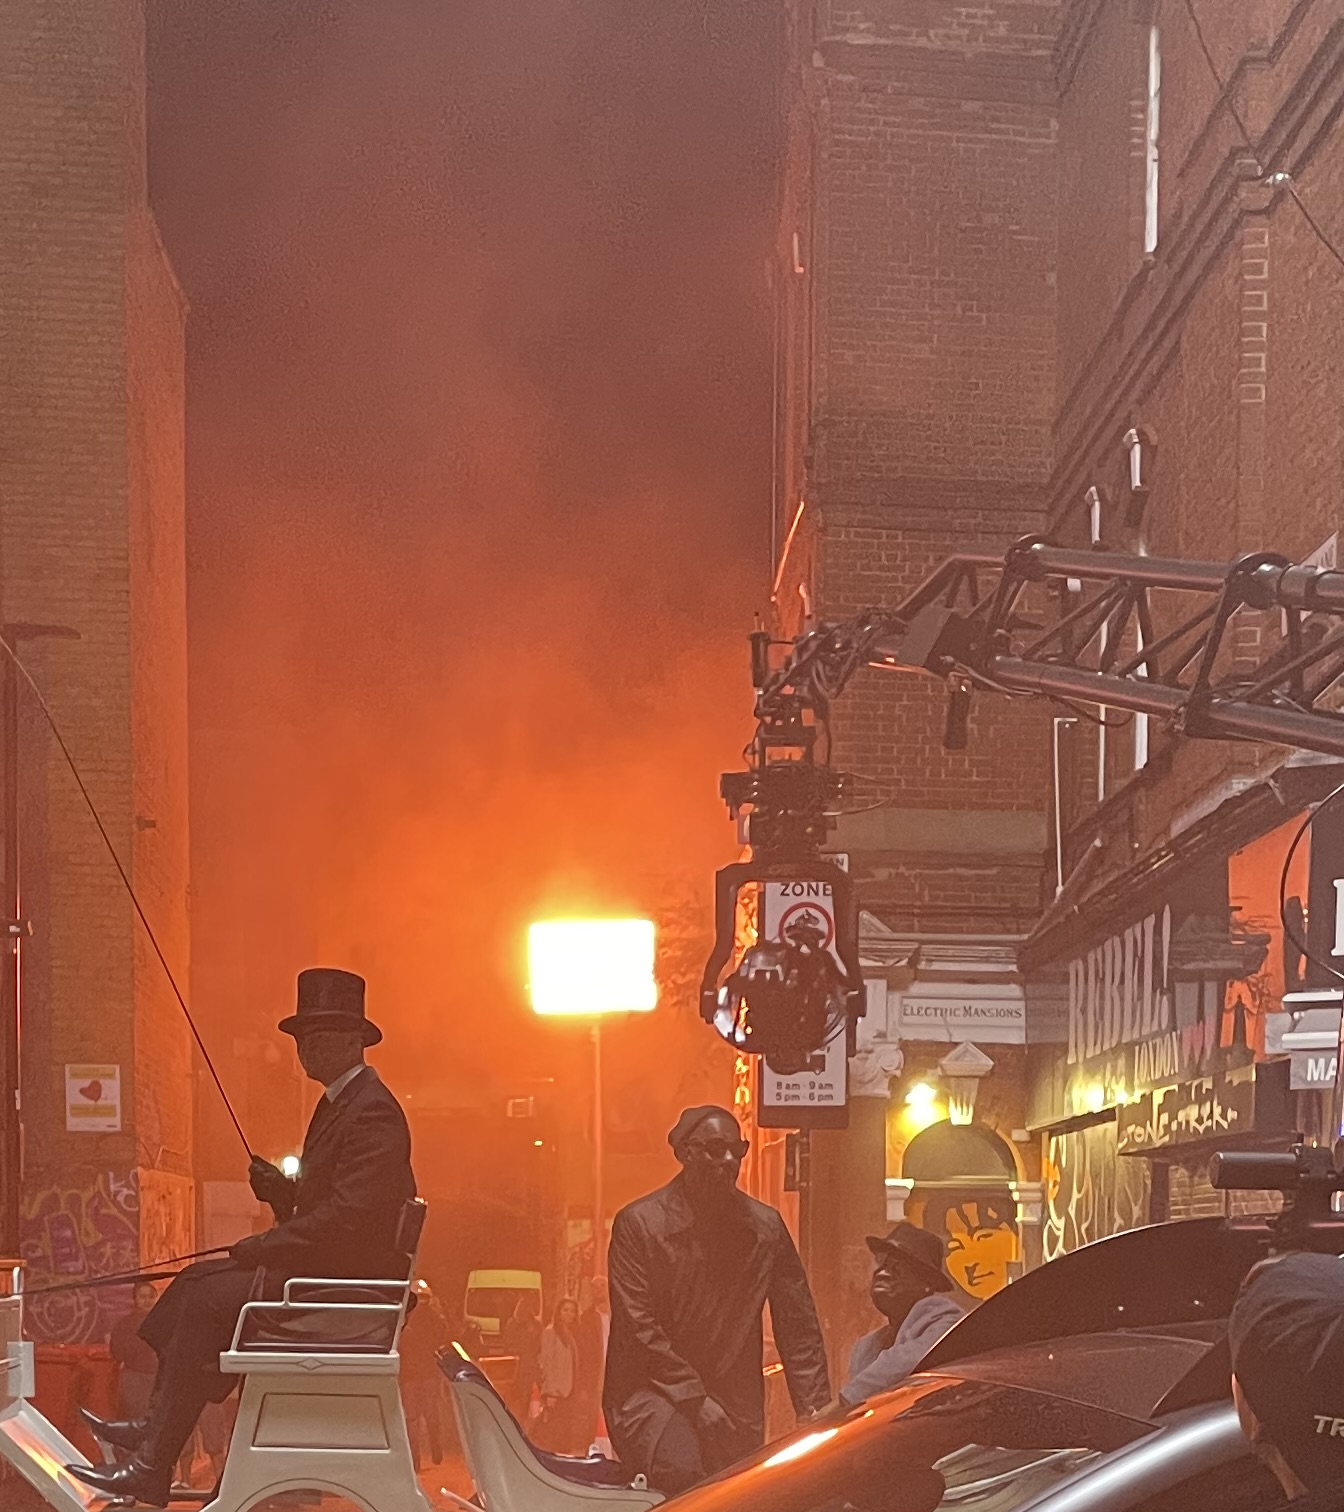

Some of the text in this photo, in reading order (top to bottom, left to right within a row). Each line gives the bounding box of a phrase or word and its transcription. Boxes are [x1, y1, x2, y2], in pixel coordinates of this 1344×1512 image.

[780, 882, 832, 897] ZONE
[1067, 903, 1171, 1065] REBEL!
[903, 1004, 1022, 1018] ELECTRIC MANSIONS
[1134, 1030, 1180, 1084] LONDON
